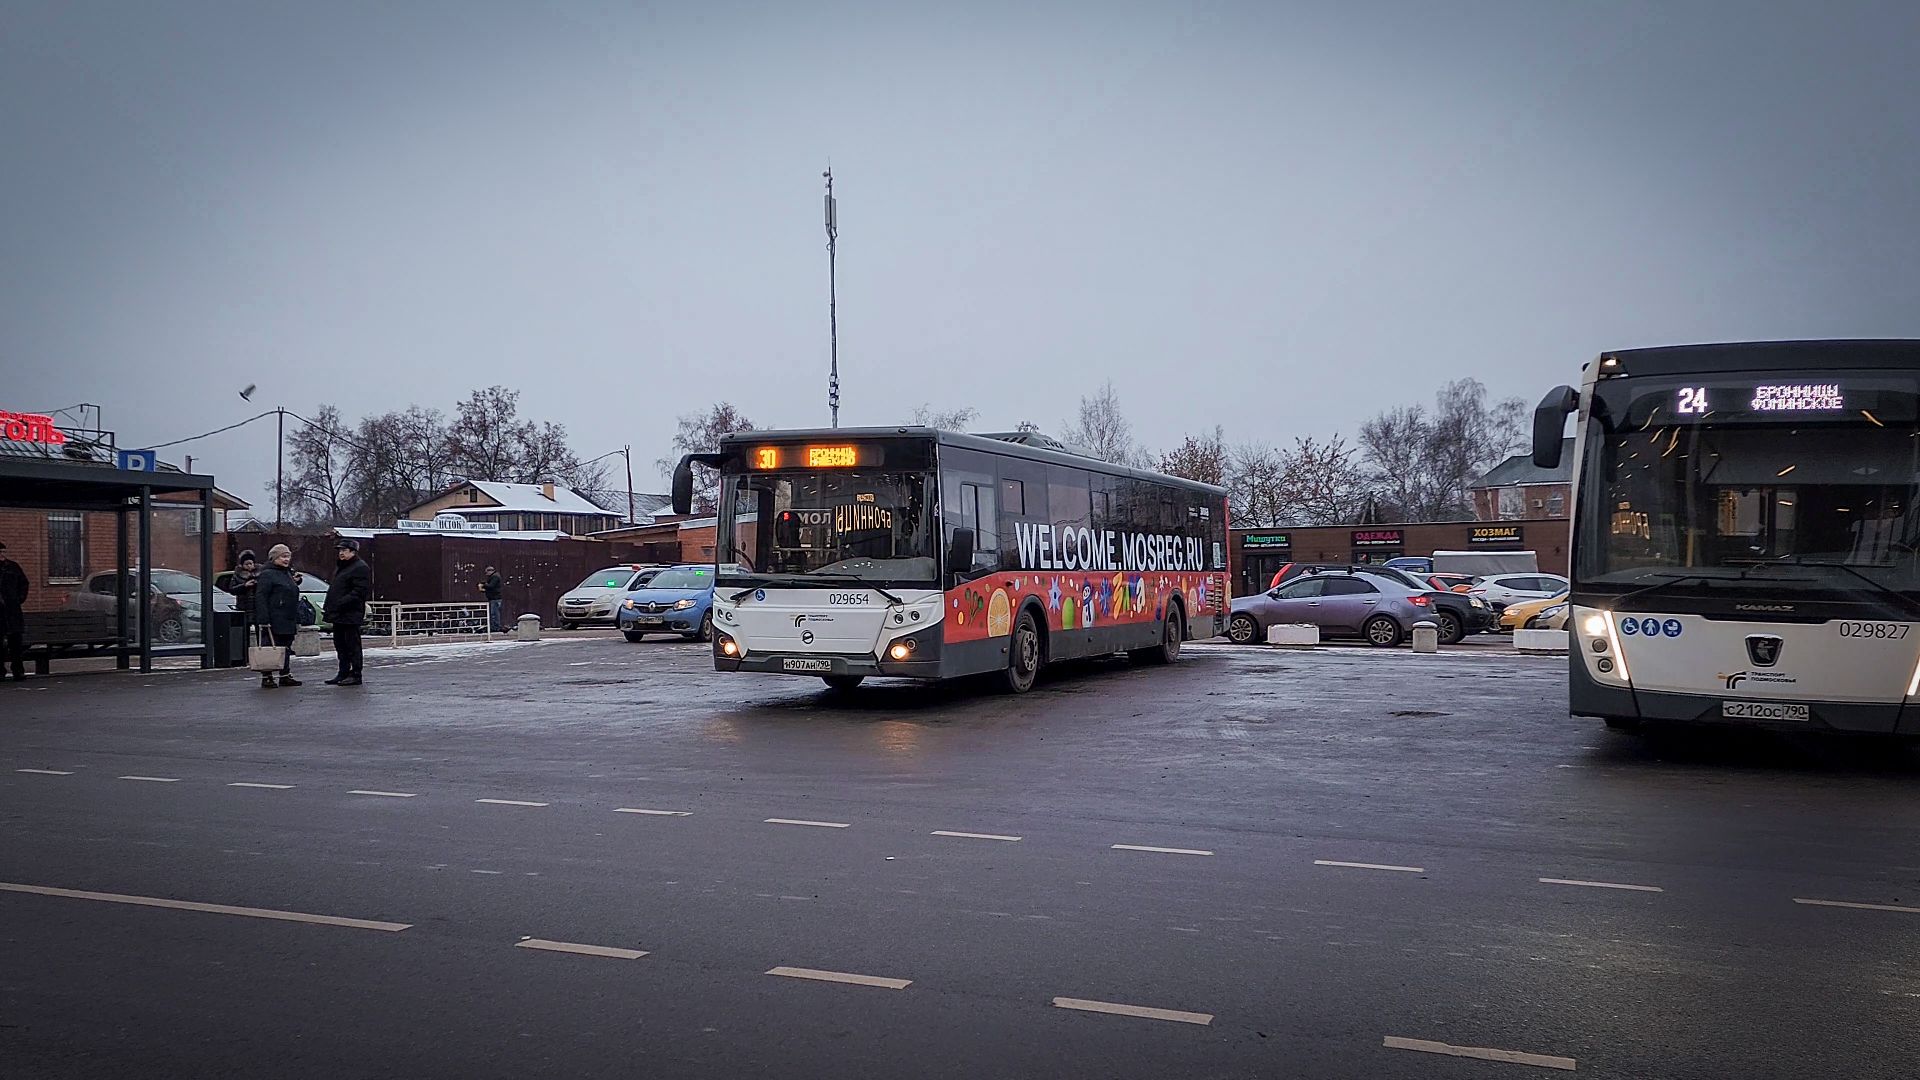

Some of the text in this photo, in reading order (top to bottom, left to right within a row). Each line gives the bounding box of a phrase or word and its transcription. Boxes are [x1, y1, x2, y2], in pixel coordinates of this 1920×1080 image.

[1678, 387, 1708, 413] 24
[760, 449, 776, 468] 30
[1356, 531, 1399, 540] ОДЕЖДА
[1473, 527, 1517, 537] ХОЗМАГ
[1014, 522, 1204, 572] WELCOME.MOSREG.RU
[829, 593, 869, 605] 029654
[1840, 622, 1910, 639] 029827
[817, 660, 829, 668] 790
[1784, 705, 1806, 716] 790
